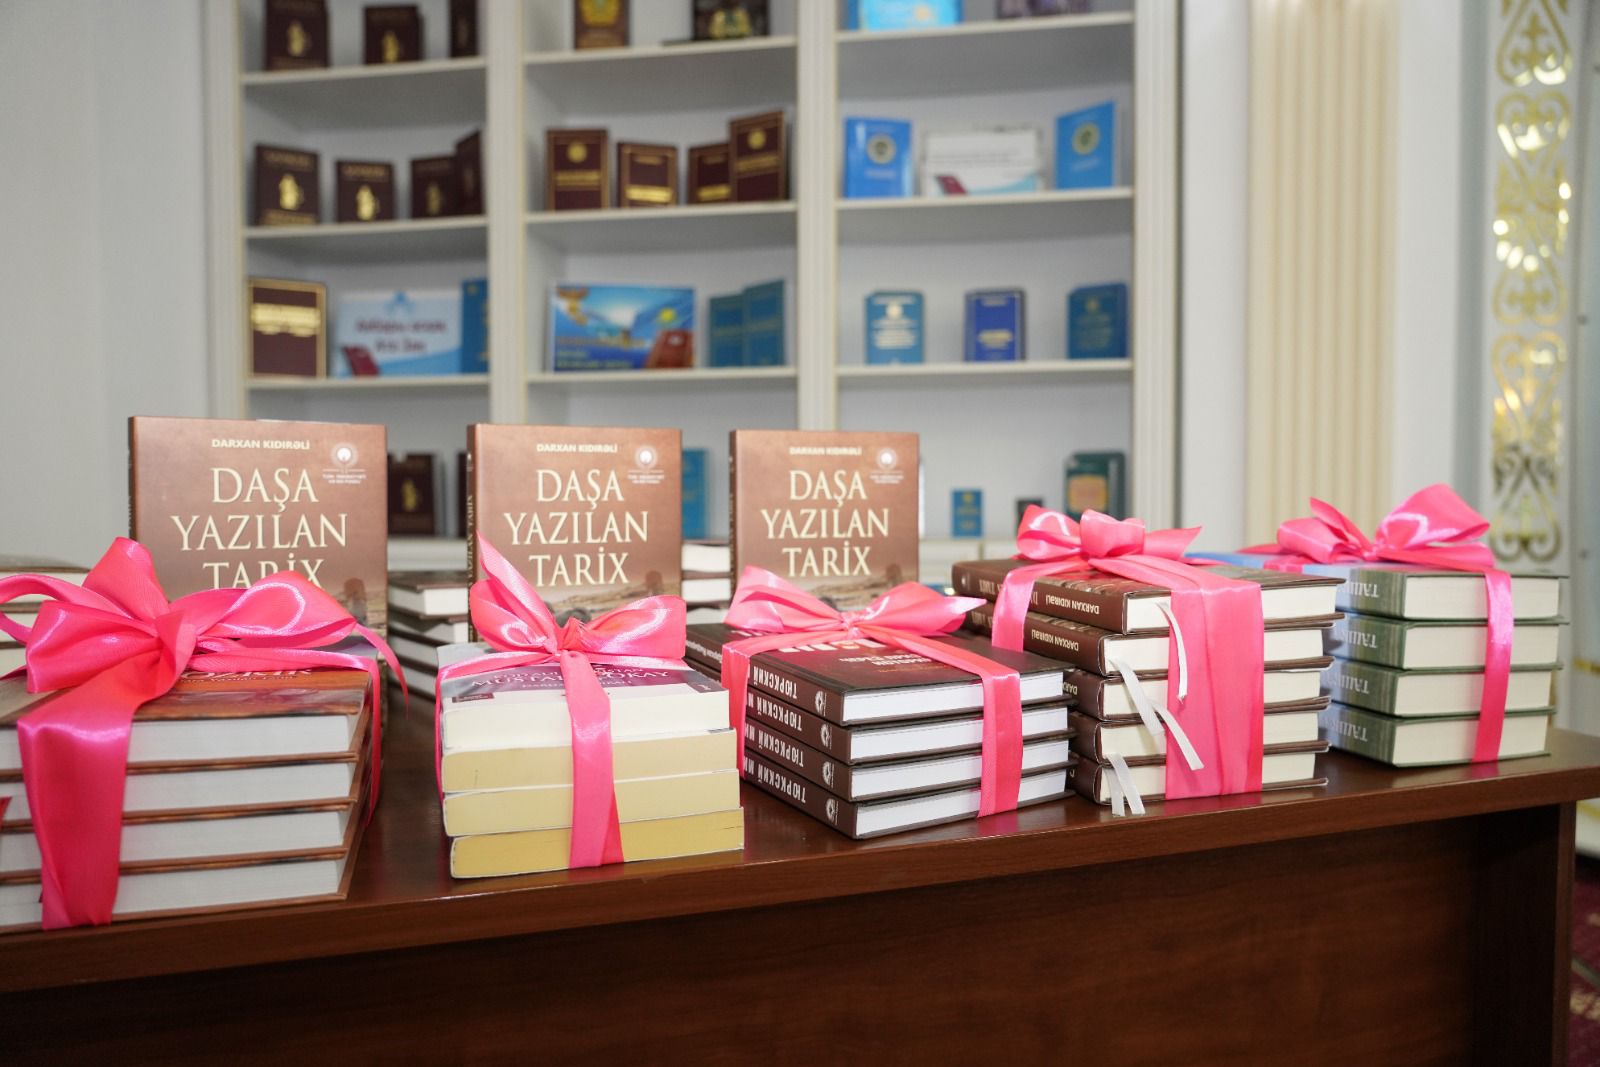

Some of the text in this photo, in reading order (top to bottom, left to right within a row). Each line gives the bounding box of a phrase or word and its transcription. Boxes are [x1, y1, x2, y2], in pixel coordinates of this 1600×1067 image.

[212, 438, 260, 449] DARXAN
[537, 443, 576, 453] DARXAN
[210, 467, 319, 512] DAŞA
[536, 469, 624, 510] DAŞA
[789, 469, 867, 507] DAŞA
[170, 513, 347, 551] YAZILAN
[504, 511, 649, 545] YAZILAN
[760, 508, 889, 540] YAZILAN
[528, 547, 629, 587] TARİX
[782, 540, 871, 577] TARİX
[1071, 599, 1100, 614] DARXAN
[1053, 636, 1079, 652] DARXAN
[753, 666, 797, 699] ТЮРКСКИЙ
[757, 697, 802, 731] ТЮРКСКИЙ
[759, 730, 804, 768] ТЮРКСКИЙ
[758, 763, 806, 804] ТЮРКСКИЙ
